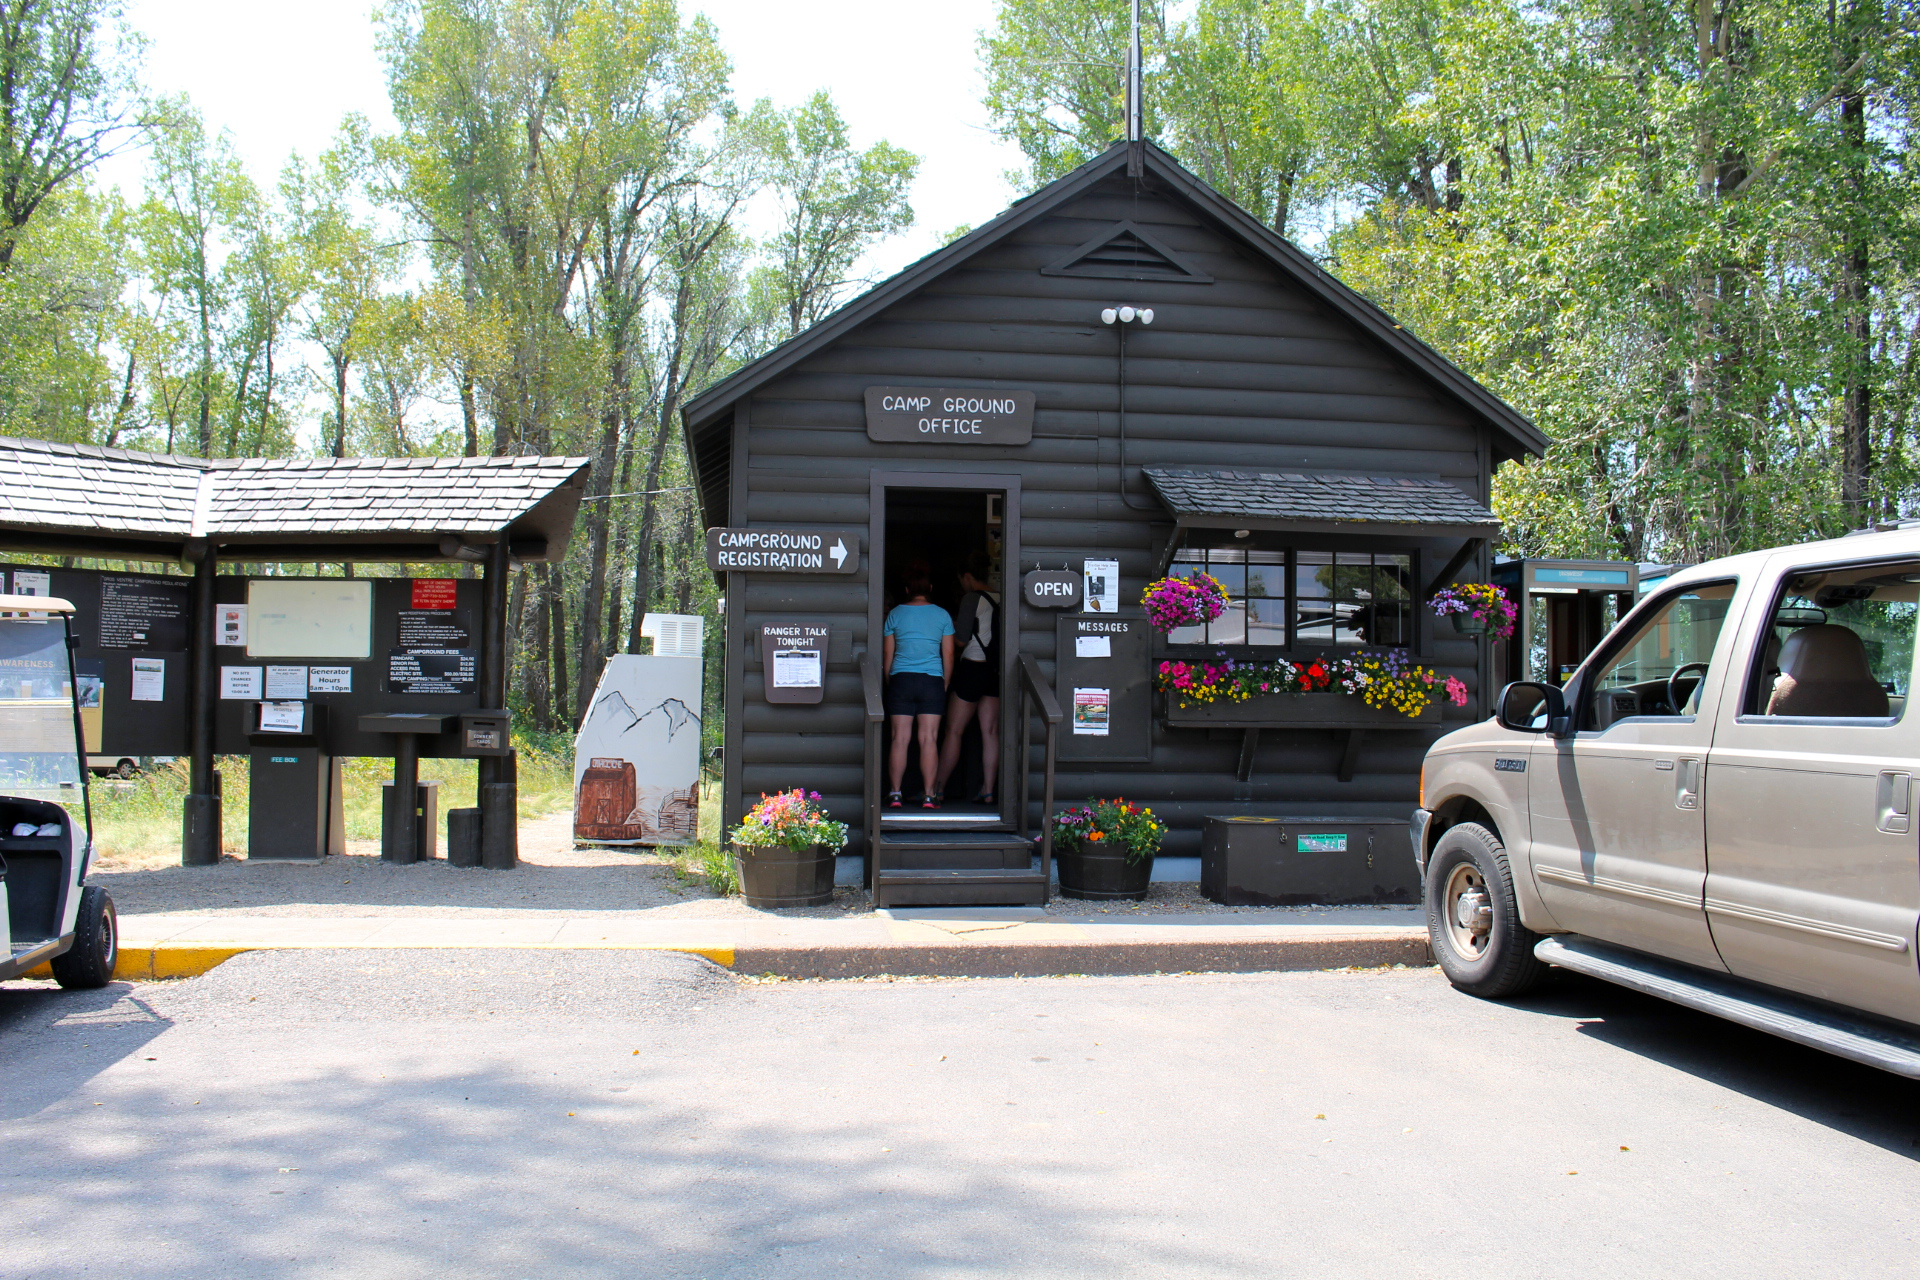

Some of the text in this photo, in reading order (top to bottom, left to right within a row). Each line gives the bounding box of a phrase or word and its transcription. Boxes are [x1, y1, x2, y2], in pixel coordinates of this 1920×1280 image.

[882, 395, 1016, 414] CAMP GROUND
[918, 418, 982, 434] OFFICE
[718, 532, 822, 550] CAMPGROUND
[718, 552, 822, 568] REGISTRATION
[1034, 582, 1073, 596] OPEN
[764, 627, 827, 636] RANGER TALK
[1078, 622, 1128, 632] MESSAGES
[777, 638, 814, 646] TONIGHT
